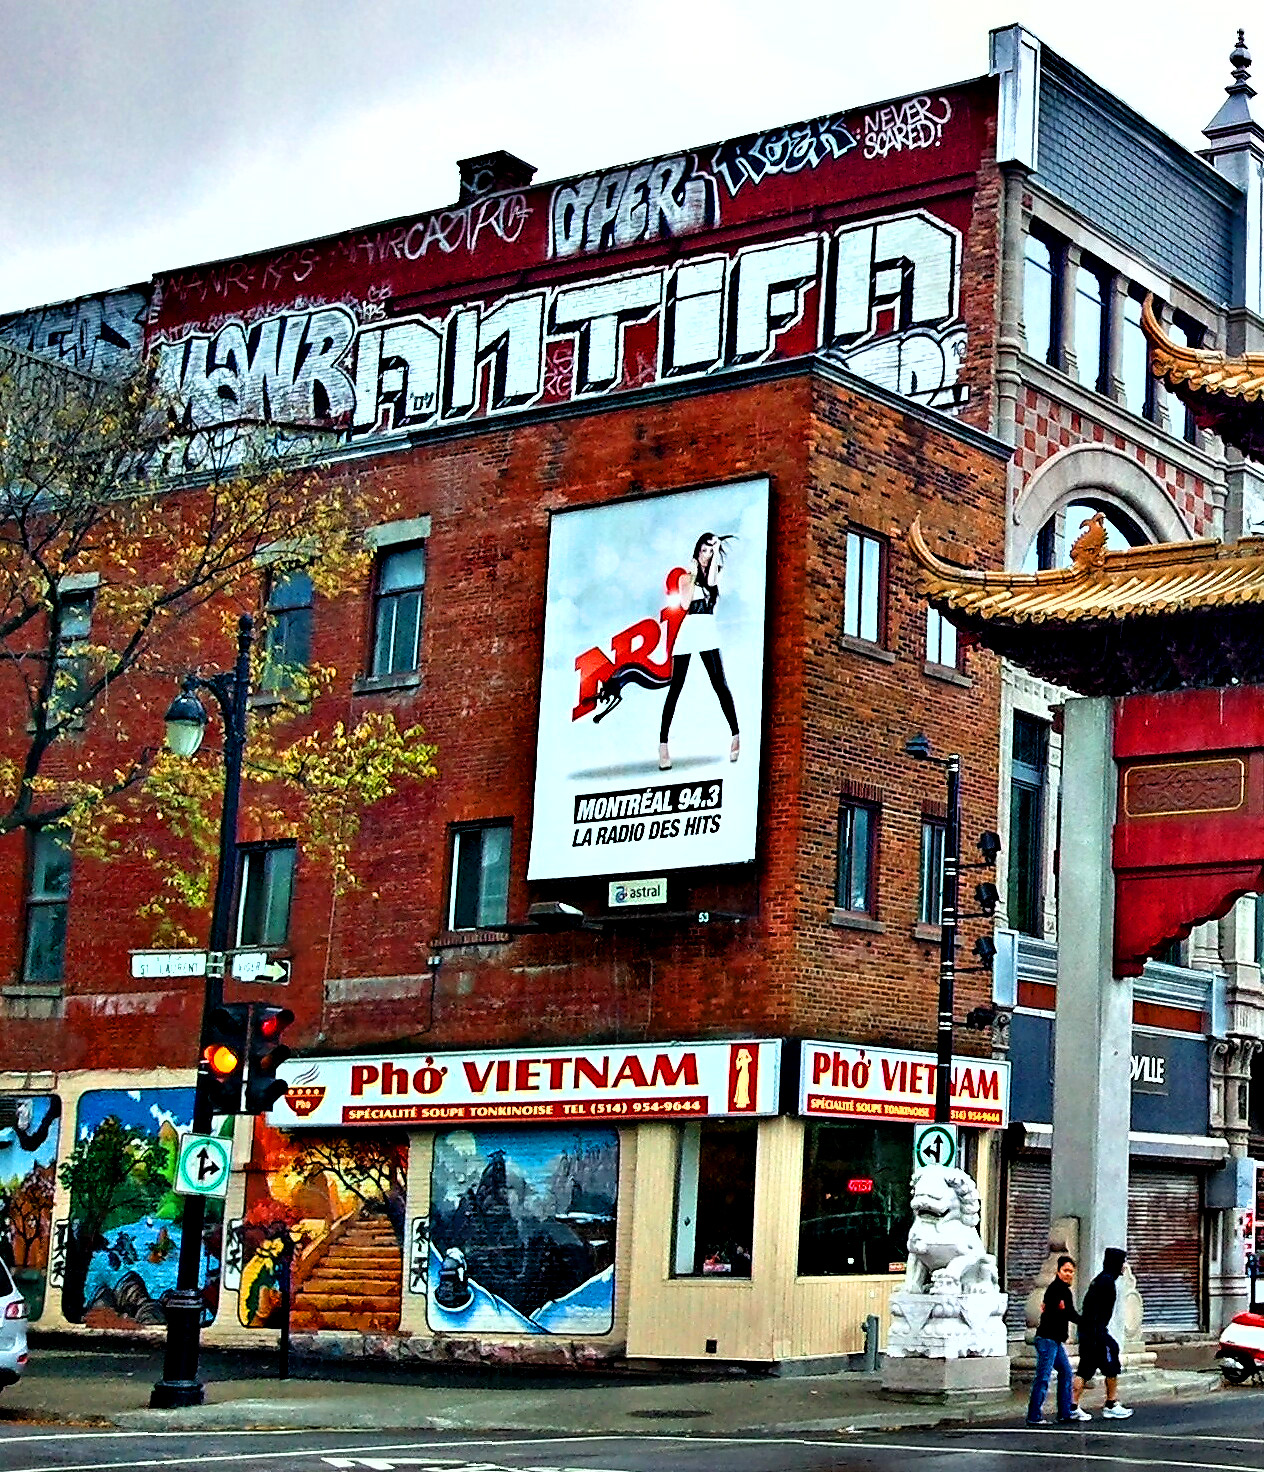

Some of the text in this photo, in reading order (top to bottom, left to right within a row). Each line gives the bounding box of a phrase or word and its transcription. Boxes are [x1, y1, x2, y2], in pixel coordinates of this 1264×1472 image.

[865, 96, 952, 133] NEVER
[864, 120, 942, 160] SCARED!
[576, 784, 721, 822] MONTRÉAL 94.3
[571, 813, 722, 848] LA RADIO DES HITS
[629, 884, 661, 899] astral
[350, 1052, 700, 1096] Phở VIETNAM
[812, 1049, 872, 1089] Phở
[348, 1100, 702, 1120] SPÉCIALITÉ SOUPE TONKINOISE TEL (514) 954-9644
